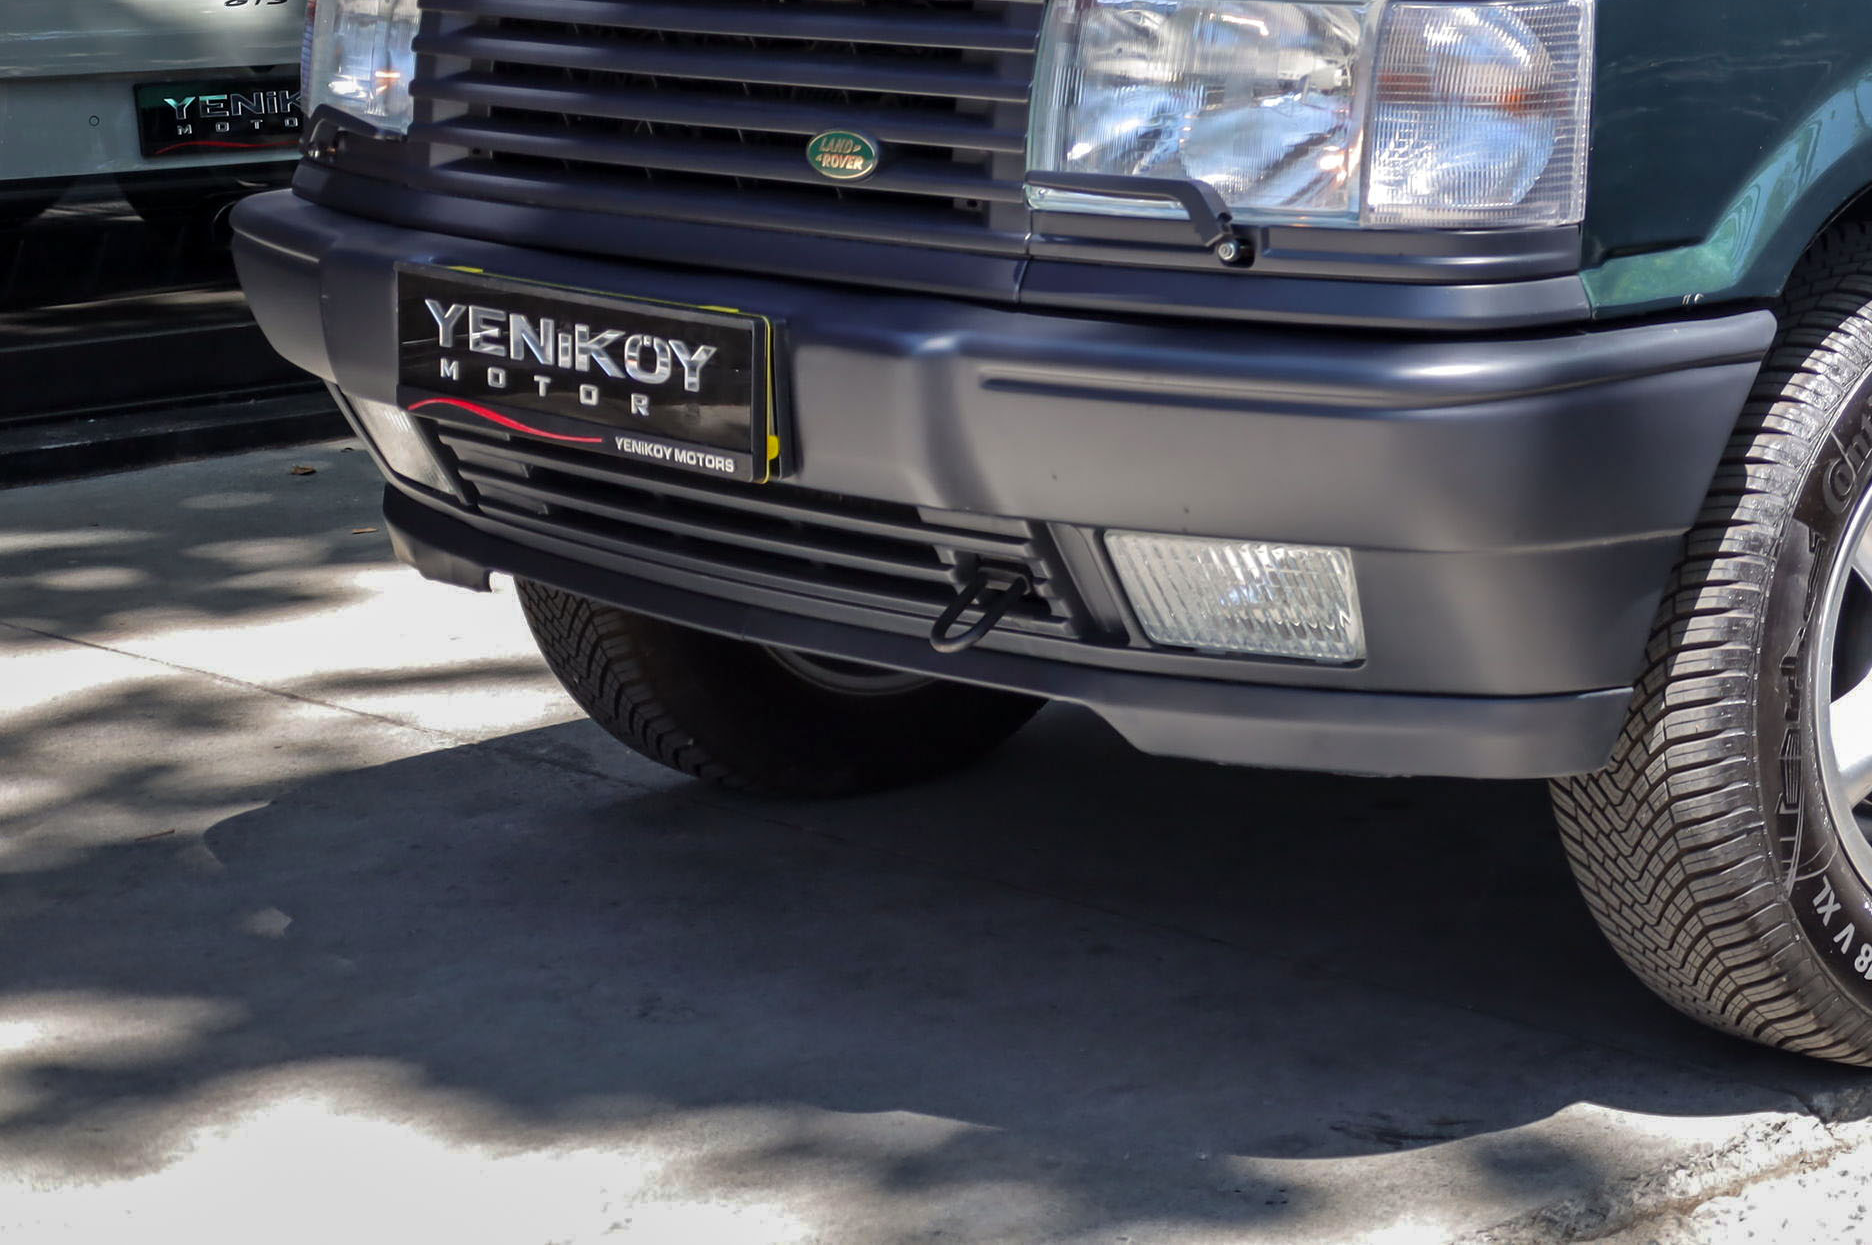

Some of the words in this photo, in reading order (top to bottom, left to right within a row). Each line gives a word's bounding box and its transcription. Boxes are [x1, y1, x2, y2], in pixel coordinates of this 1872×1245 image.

[819, 137, 853, 154] LAND
[822, 153, 865, 170] ROVER
[440, 357, 650, 416] MOTOR
[674, 448, 735, 473] MOTORS
[1812, 874, 1842, 927] XL
[1832, 921, 1856, 955] V
